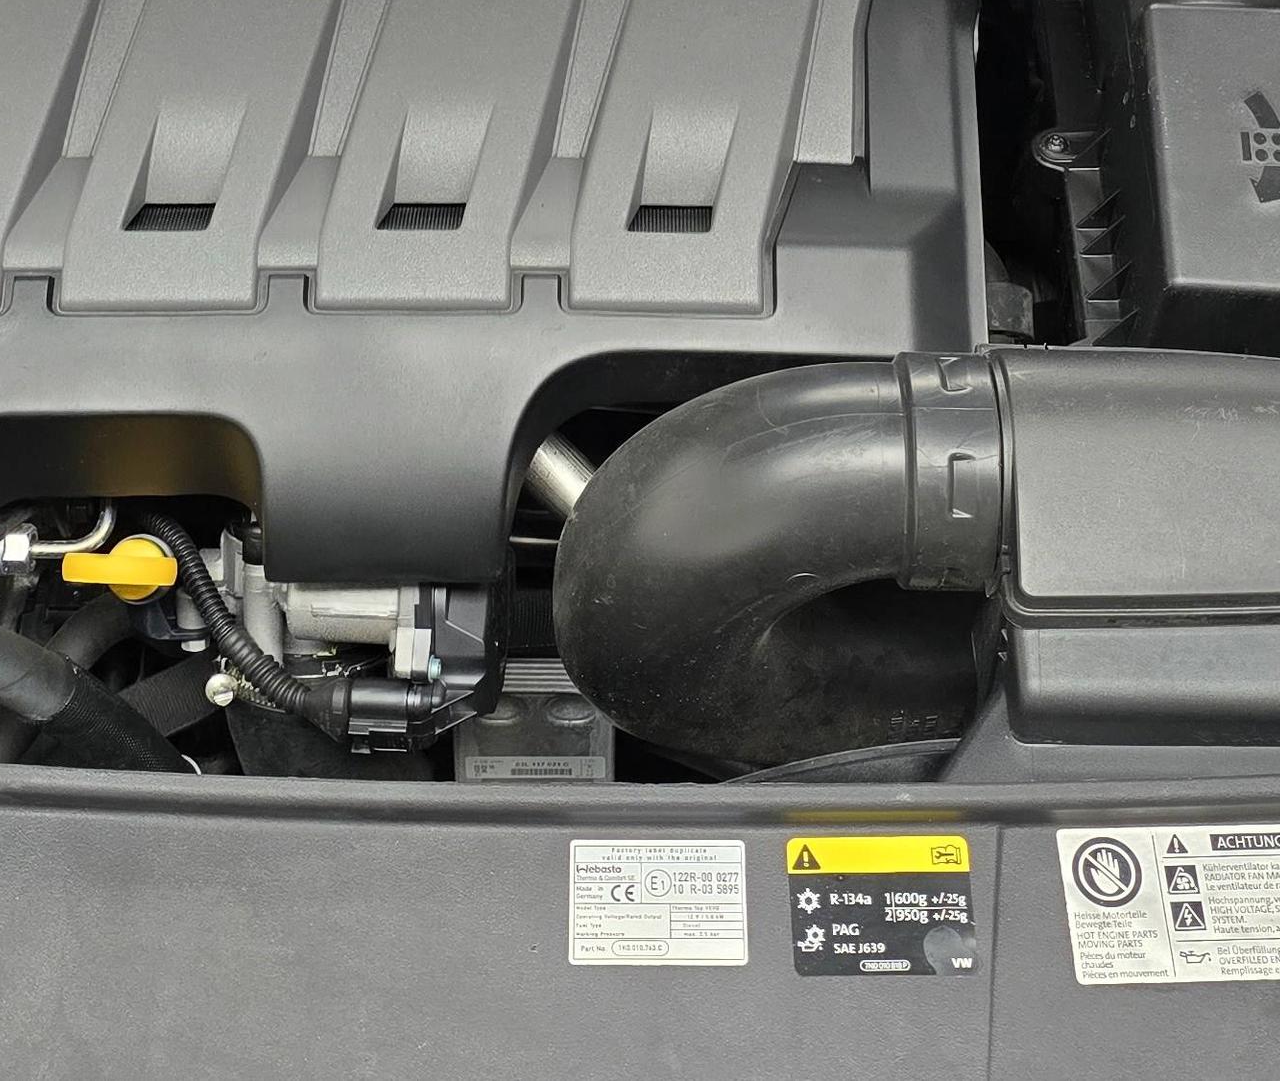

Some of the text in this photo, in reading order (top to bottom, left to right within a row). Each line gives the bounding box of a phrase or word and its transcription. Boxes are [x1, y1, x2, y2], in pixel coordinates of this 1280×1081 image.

[576, 865, 622, 874] Webasto
[1202, 862, 1269, 872] Kühlerventilator
[673, 872, 739, 882] 122R-00 0277
[1204, 872, 1246, 882] RADIATOR
[1248, 872, 1265, 880] FAN
[651, 876, 665, 890] E1
[1206, 883, 1216, 891] Le
[1216, 882, 1261, 891] ventilateur
[1264, 881, 1274, 890] de
[611, 884, 635, 902] CE
[673, 884, 740, 894] 10 R-03 5895
[829, 892, 967, 907] R-134a 1 600g +/-25g
[1210, 906, 1233, 914] HIGH
[1234, 905, 1275, 914] VOLTAGE,
[885, 909, 968, 924] 2 950g +/-25g
[1074, 910, 1148, 920] Heisse Motorteile
[1212, 916, 1247, 924] SYSTEM.
[832, 923, 860, 936] PAG
[1075, 919, 1133, 930] Bewegte Teile
[1213, 925, 1239, 933] Haute
[1241, 924, 1275, 934] tension,
[1077, 930, 1158, 940] HOT ENGINE PARTS
[833, 942, 886, 954] SAE J639
[1078, 939, 1143, 949] MOVING PARTS
[1080, 951, 1104, 960] Pièces
[1117, 951, 1146, 959] moteur
[1218, 955, 1269, 965] OVERFILLED
[951, 958, 973, 968] VW
[1082, 961, 1114, 969] chaudes
[1083, 970, 1107, 979] Pièces
[1119, 969, 1169, 977] mouvement
[1220, 966, 1273, 976] Remplissage
